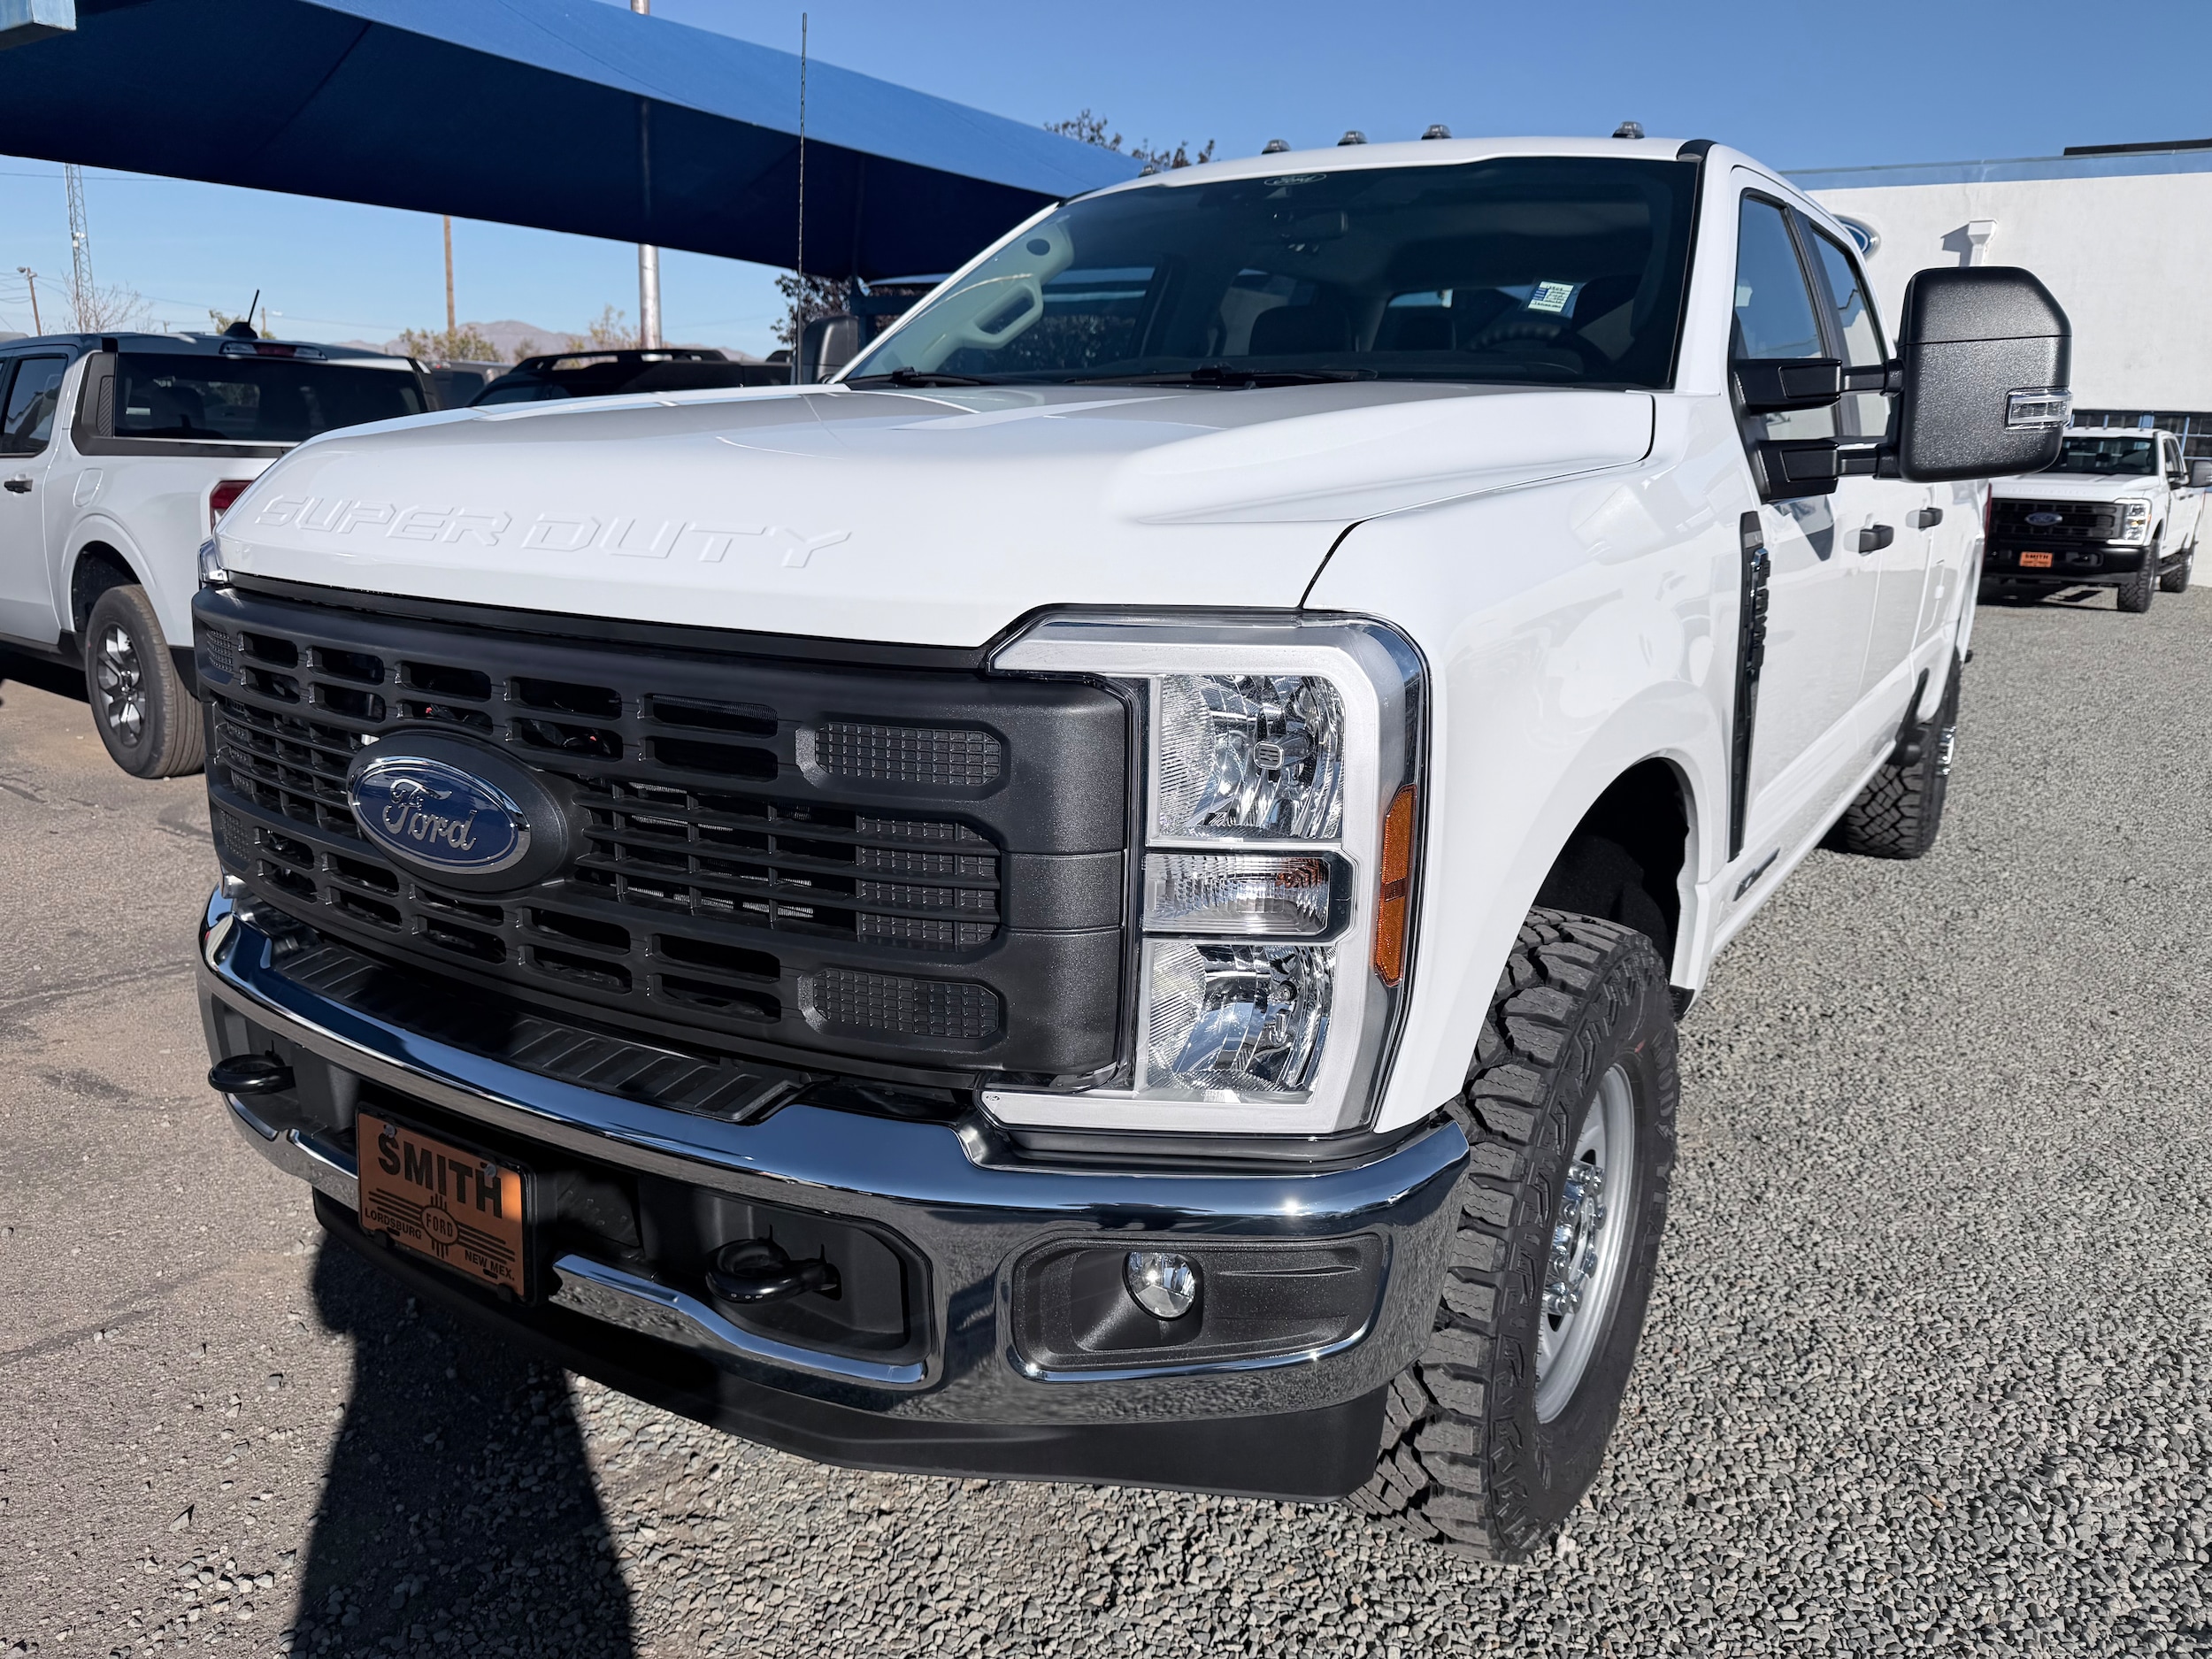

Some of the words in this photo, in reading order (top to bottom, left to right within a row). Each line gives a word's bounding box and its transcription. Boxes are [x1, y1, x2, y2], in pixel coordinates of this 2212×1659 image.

[256, 494, 513, 547] SUPER
[521, 511, 852, 569] DUTY
[381, 778, 478, 851] Ford
[377, 1132, 503, 1219] SMITH
[365, 1207, 422, 1240] LORDSBURG
[426, 1211, 454, 1238] FORD
[465, 1249, 488, 1269] NEW
[490, 1263, 515, 1281] MEX.
